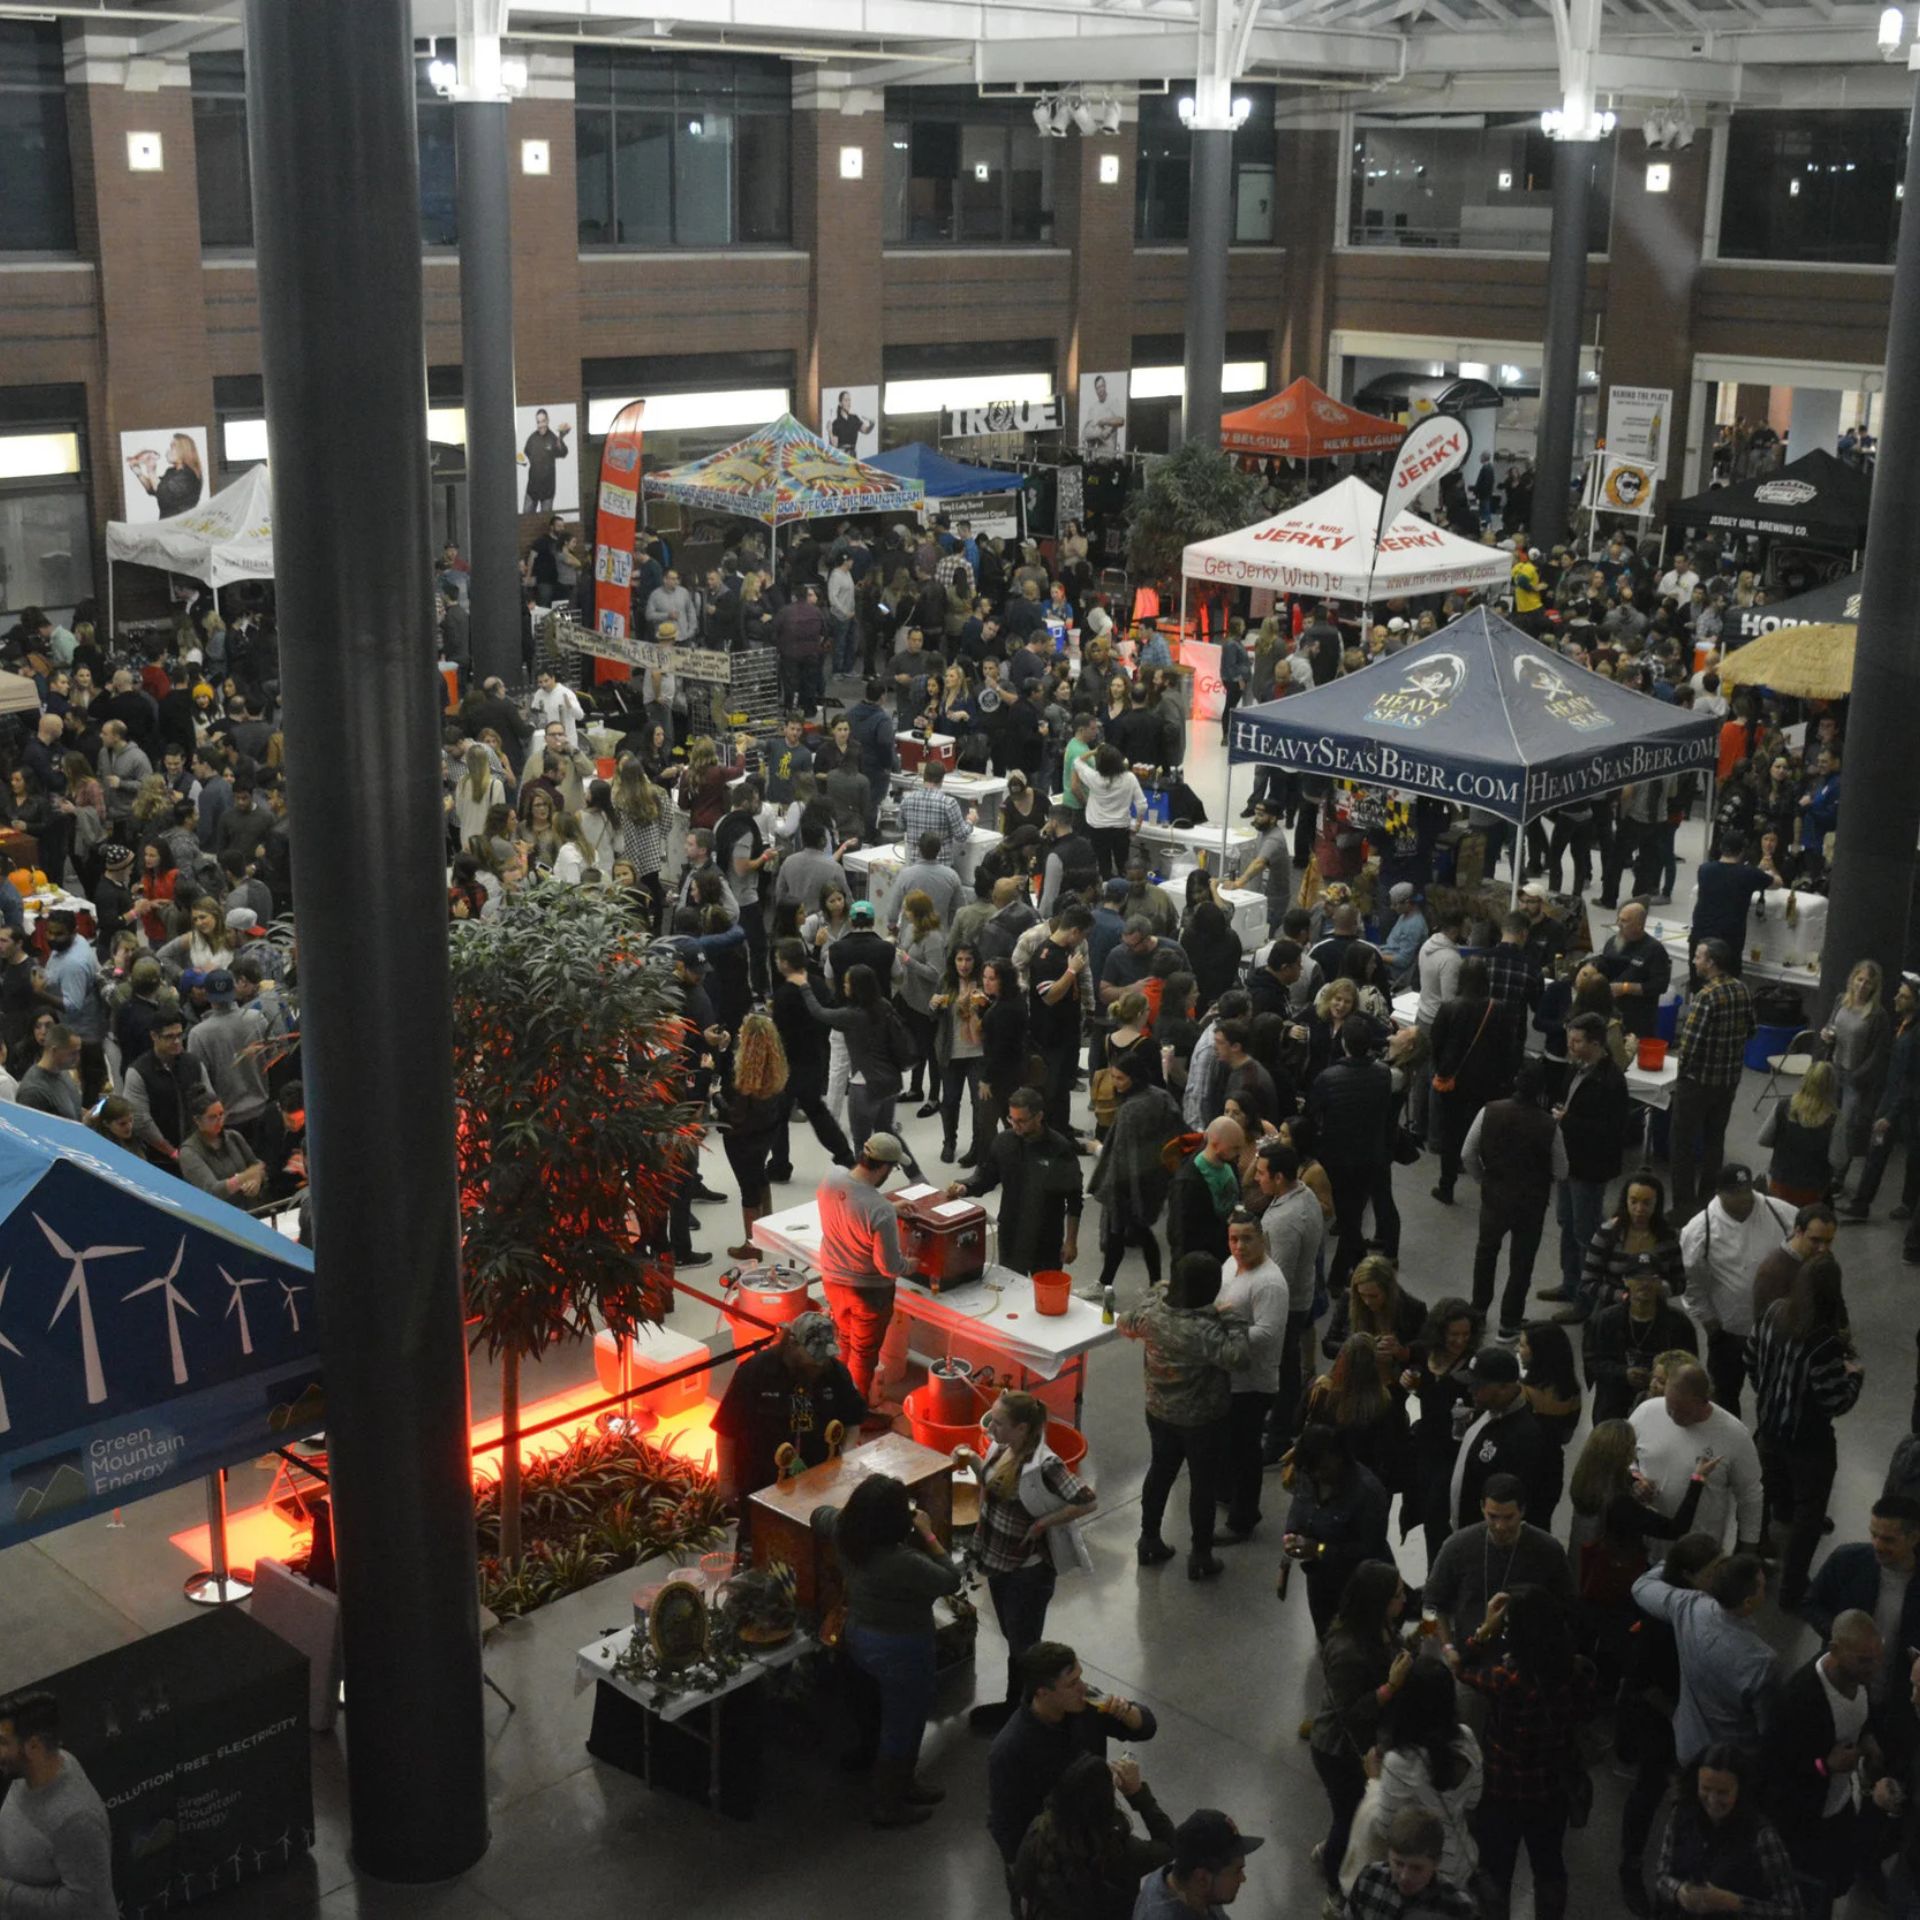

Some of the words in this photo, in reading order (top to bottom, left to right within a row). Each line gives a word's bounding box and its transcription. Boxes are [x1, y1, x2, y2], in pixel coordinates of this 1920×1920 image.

[1612, 389, 1636, 400] BEHIND
[1637, 390, 1649, 400] THE
[1650, 391, 1670, 402] PLATE
[1232, 432, 1291, 450] BELGIUM
[1323, 438, 1351, 450] NEW
[1353, 433, 1403, 448] BELGIUM
[1397, 431, 1461, 489] JERKY
[603, 490, 631, 512] JERSEY
[1286, 521, 1303, 529] MR
[1319, 524, 1344, 535] MRS
[1709, 516, 1738, 527] JERSEY
[1738, 518, 1756, 530] GIRL
[1758, 521, 1794, 535] BREWING
[1795, 526, 1809, 537] CO.
[1254, 528, 1355, 551] JERKY
[1204, 556, 1233, 577] Get
[1236, 561, 1279, 583] Jerky
[1282, 566, 1320, 588] With
[1323, 571, 1344, 593] It!
[1386, 565, 1497, 590] www.mr-mrs-jerky.com
[1371, 692, 1449, 717] HEAVY
[1544, 695, 1597, 720] HEAVY
[1372, 708, 1428, 729] SEAS
[1568, 711, 1616, 730] SEAS
[90, 1428, 151, 1457] Green
[91, 1435, 185, 1478] Mountain
[95, 1460, 168, 1496] Energy
[104, 1771, 175, 1810] OLLUTION
[216, 1716, 298, 1758] ELECTRICITY
[178, 1790, 242, 1820] Mountain
